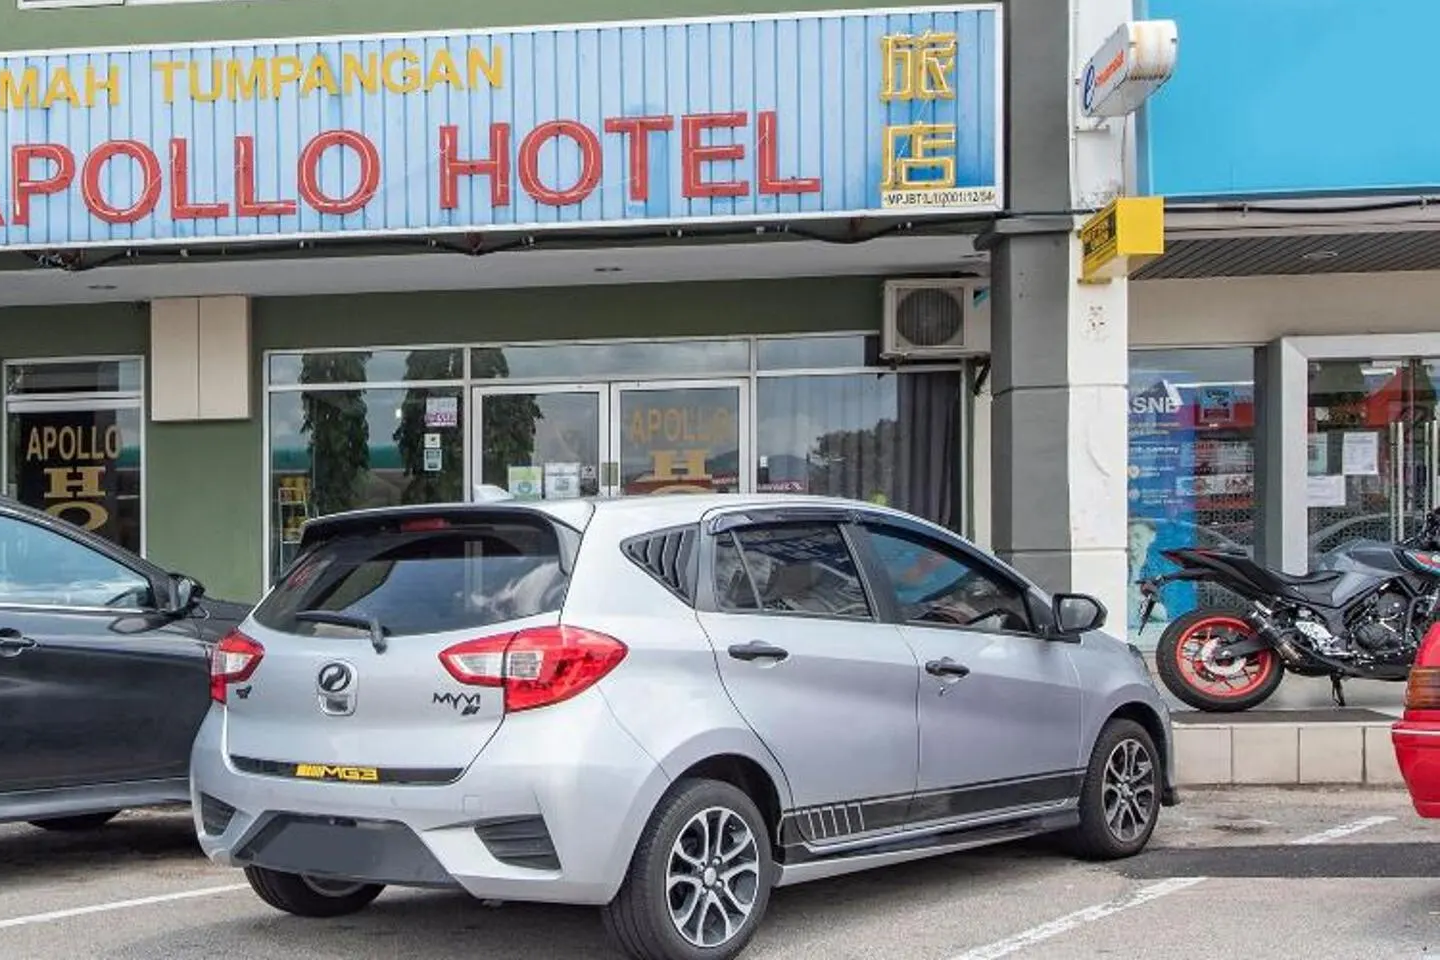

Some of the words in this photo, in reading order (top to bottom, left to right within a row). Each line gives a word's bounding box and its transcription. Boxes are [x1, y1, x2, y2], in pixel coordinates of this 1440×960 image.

[153, 46, 503, 103] TUMPANGAN
[438, 111, 821, 210] HOTEL
[1128, 396, 1181, 414] SNB
[26, 424, 122, 461] APOLLO
[631, 406, 732, 442] APOLLO
